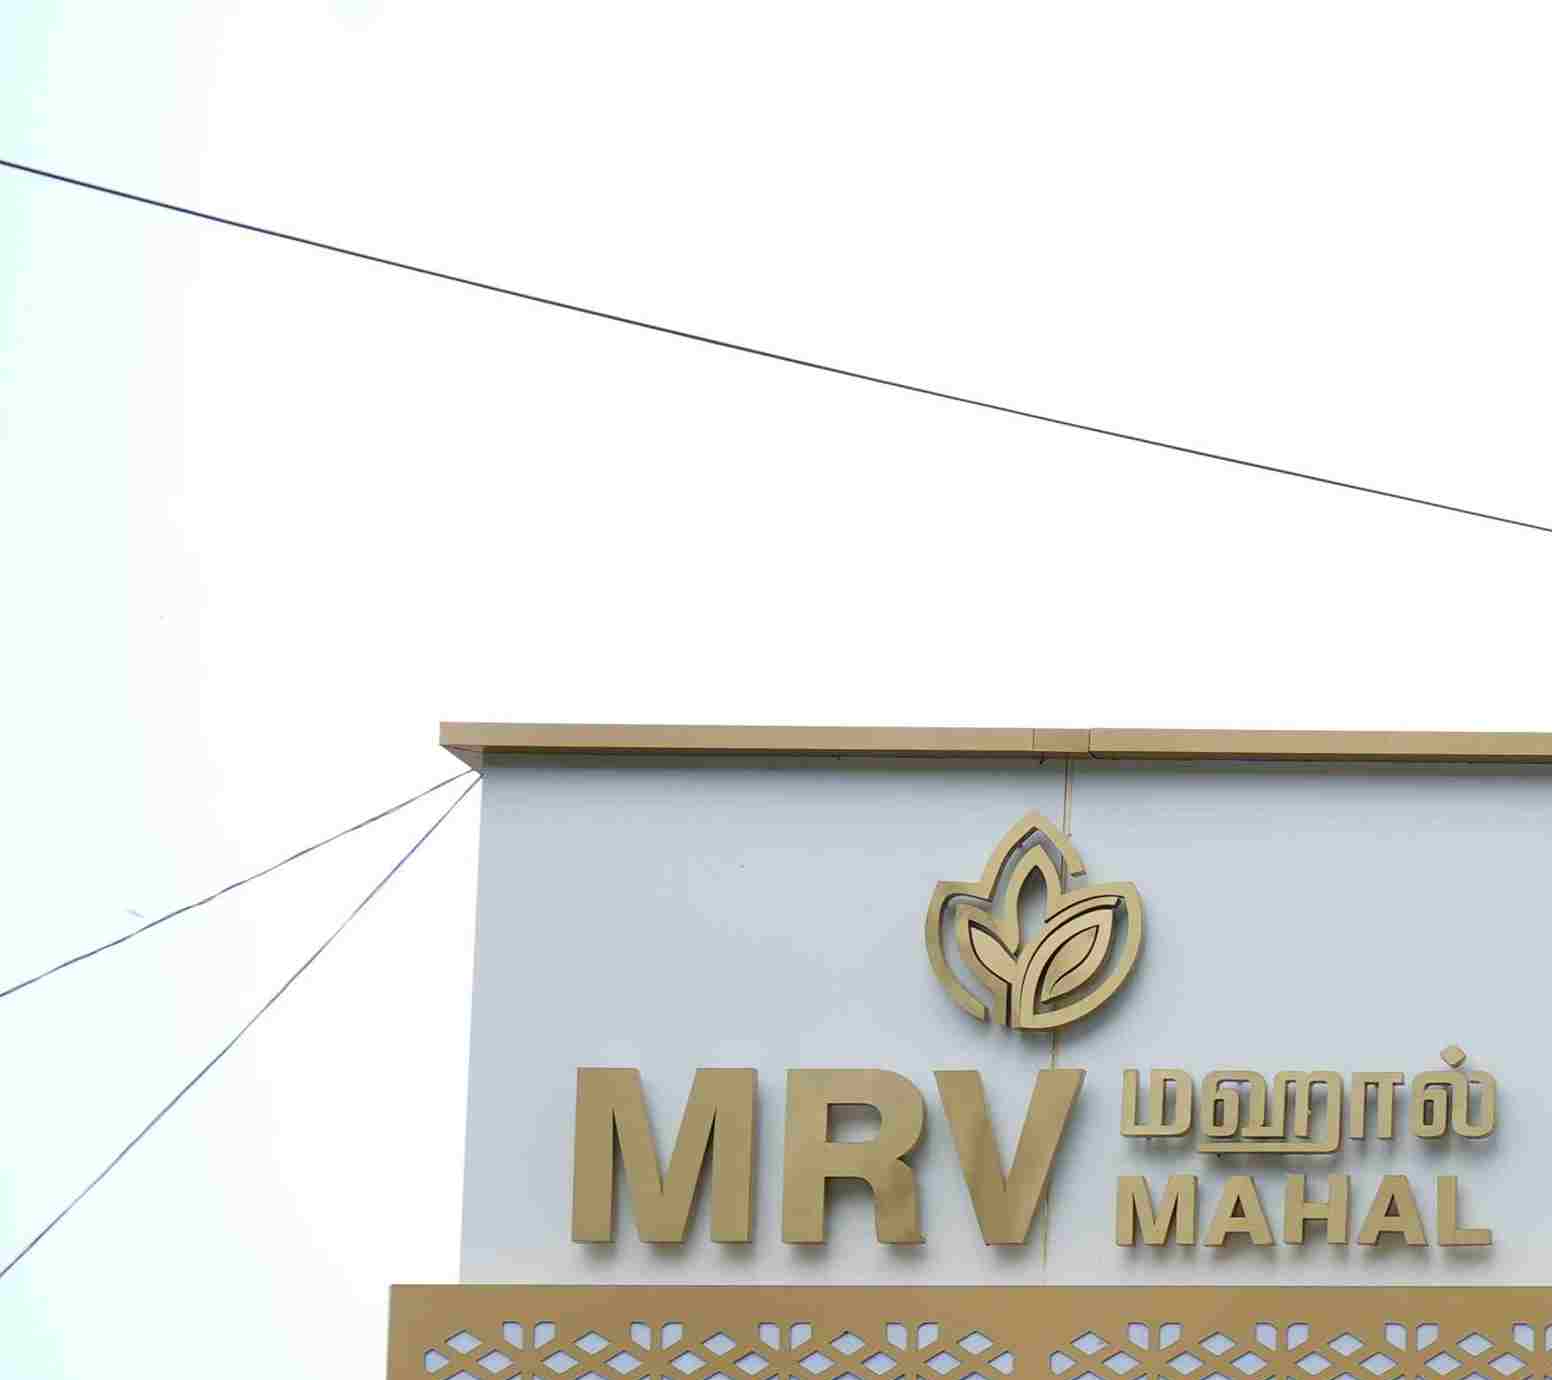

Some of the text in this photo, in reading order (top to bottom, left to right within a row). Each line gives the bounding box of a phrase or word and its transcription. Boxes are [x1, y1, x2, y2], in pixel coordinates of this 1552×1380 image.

[1119, 1043, 1498, 1156] மஹால்
[571, 1066, 1087, 1247] MRV
[1115, 1173, 1493, 1247] MAHAL
